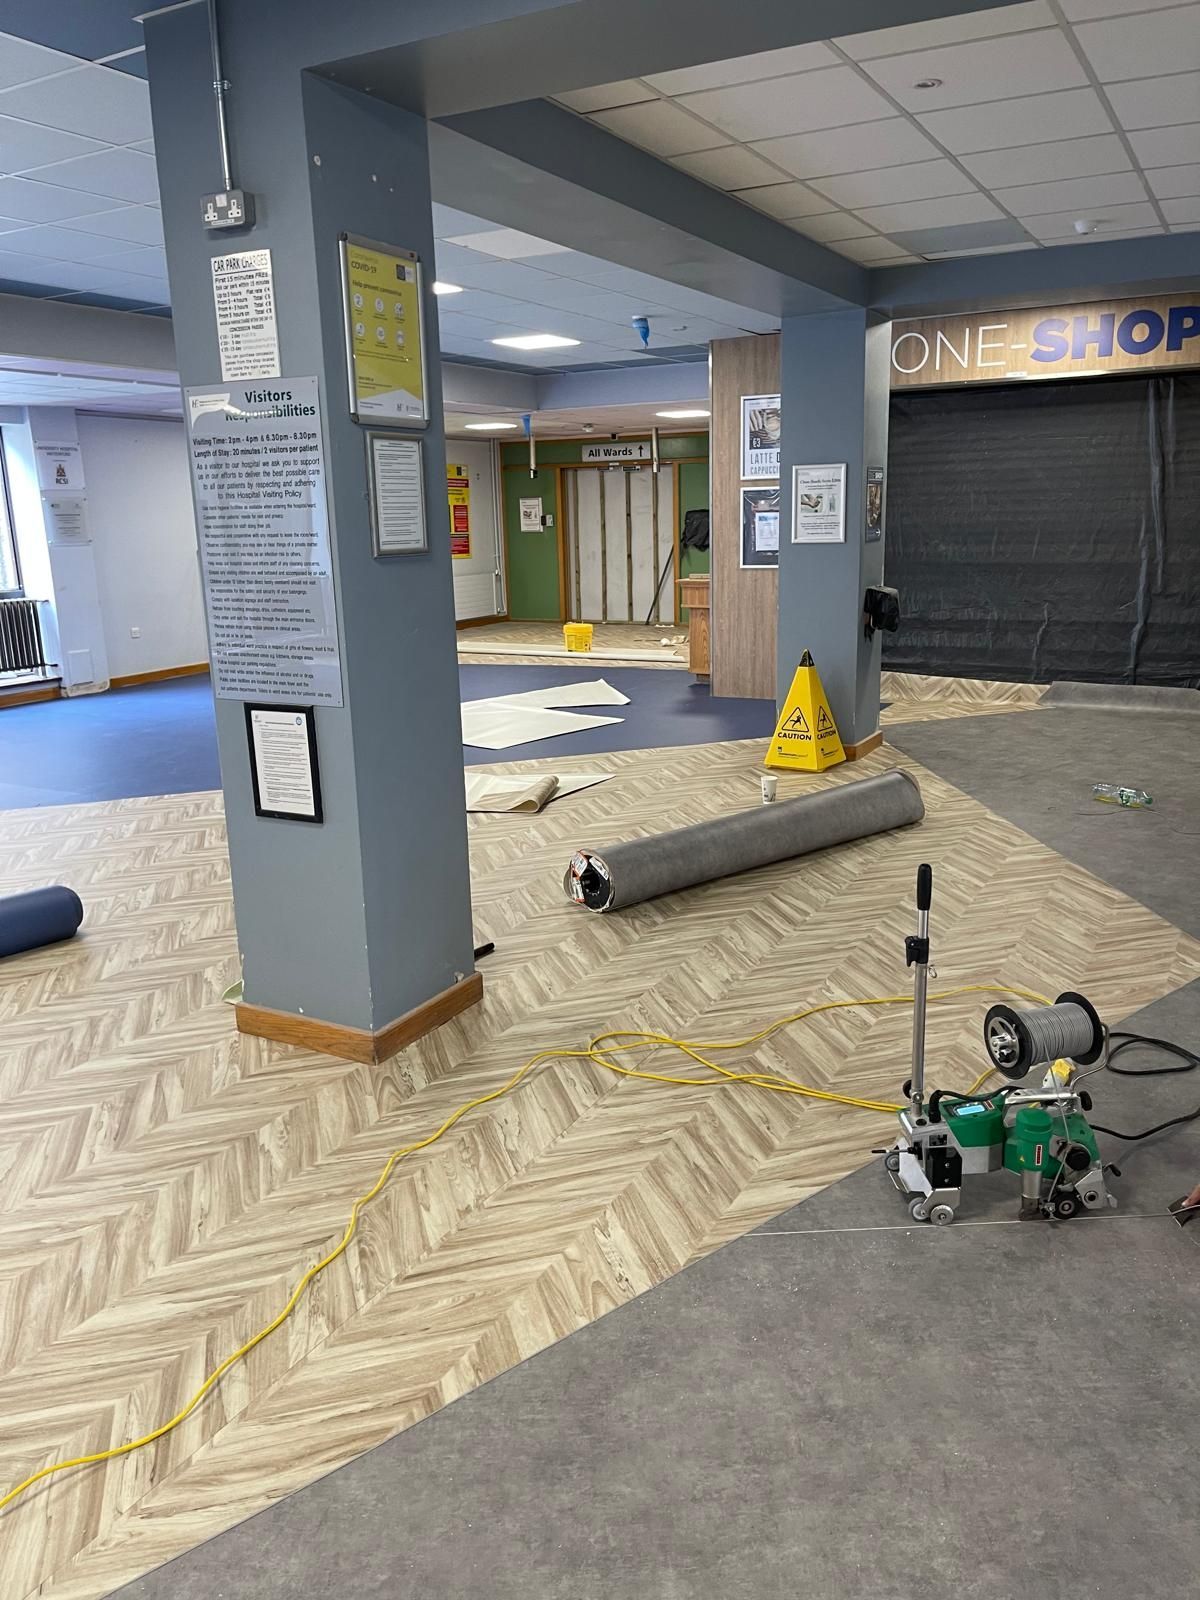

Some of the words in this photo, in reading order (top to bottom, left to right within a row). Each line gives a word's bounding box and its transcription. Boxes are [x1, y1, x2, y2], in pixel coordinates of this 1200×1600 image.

[214, 260, 226, 272] CAR
[226, 258, 241, 270] PARK
[351, 260, 376, 274] COVID-19
[892, 306, 1200, 374] ONE-SHOP
[244, 390, 292, 404] Visitors
[193, 437, 212, 446] Visiting
[228, 436, 240, 445] 2pm
[266, 434, 288, 442] 6.30pm
[294, 432, 316, 440] 8.30pm
[289, 445, 299, 454] per
[300, 444, 318, 453] patient
[588, 449, 600, 457] All
[603, 448, 632, 456] Wards
[242, 460, 260, 469] hospital
[300, 458, 320, 466] support
[750, 452, 774, 464] LATTE
[286, 468, 306, 477] possible
[256, 480, 281, 489] respecting
[295, 478, 316, 487] adhering
[237, 491, 260, 499] Hospital
[284, 490, 302, 498] Policy
[778, 732, 812, 741] CAUTION
[816, 730, 836, 740] CAUTION
